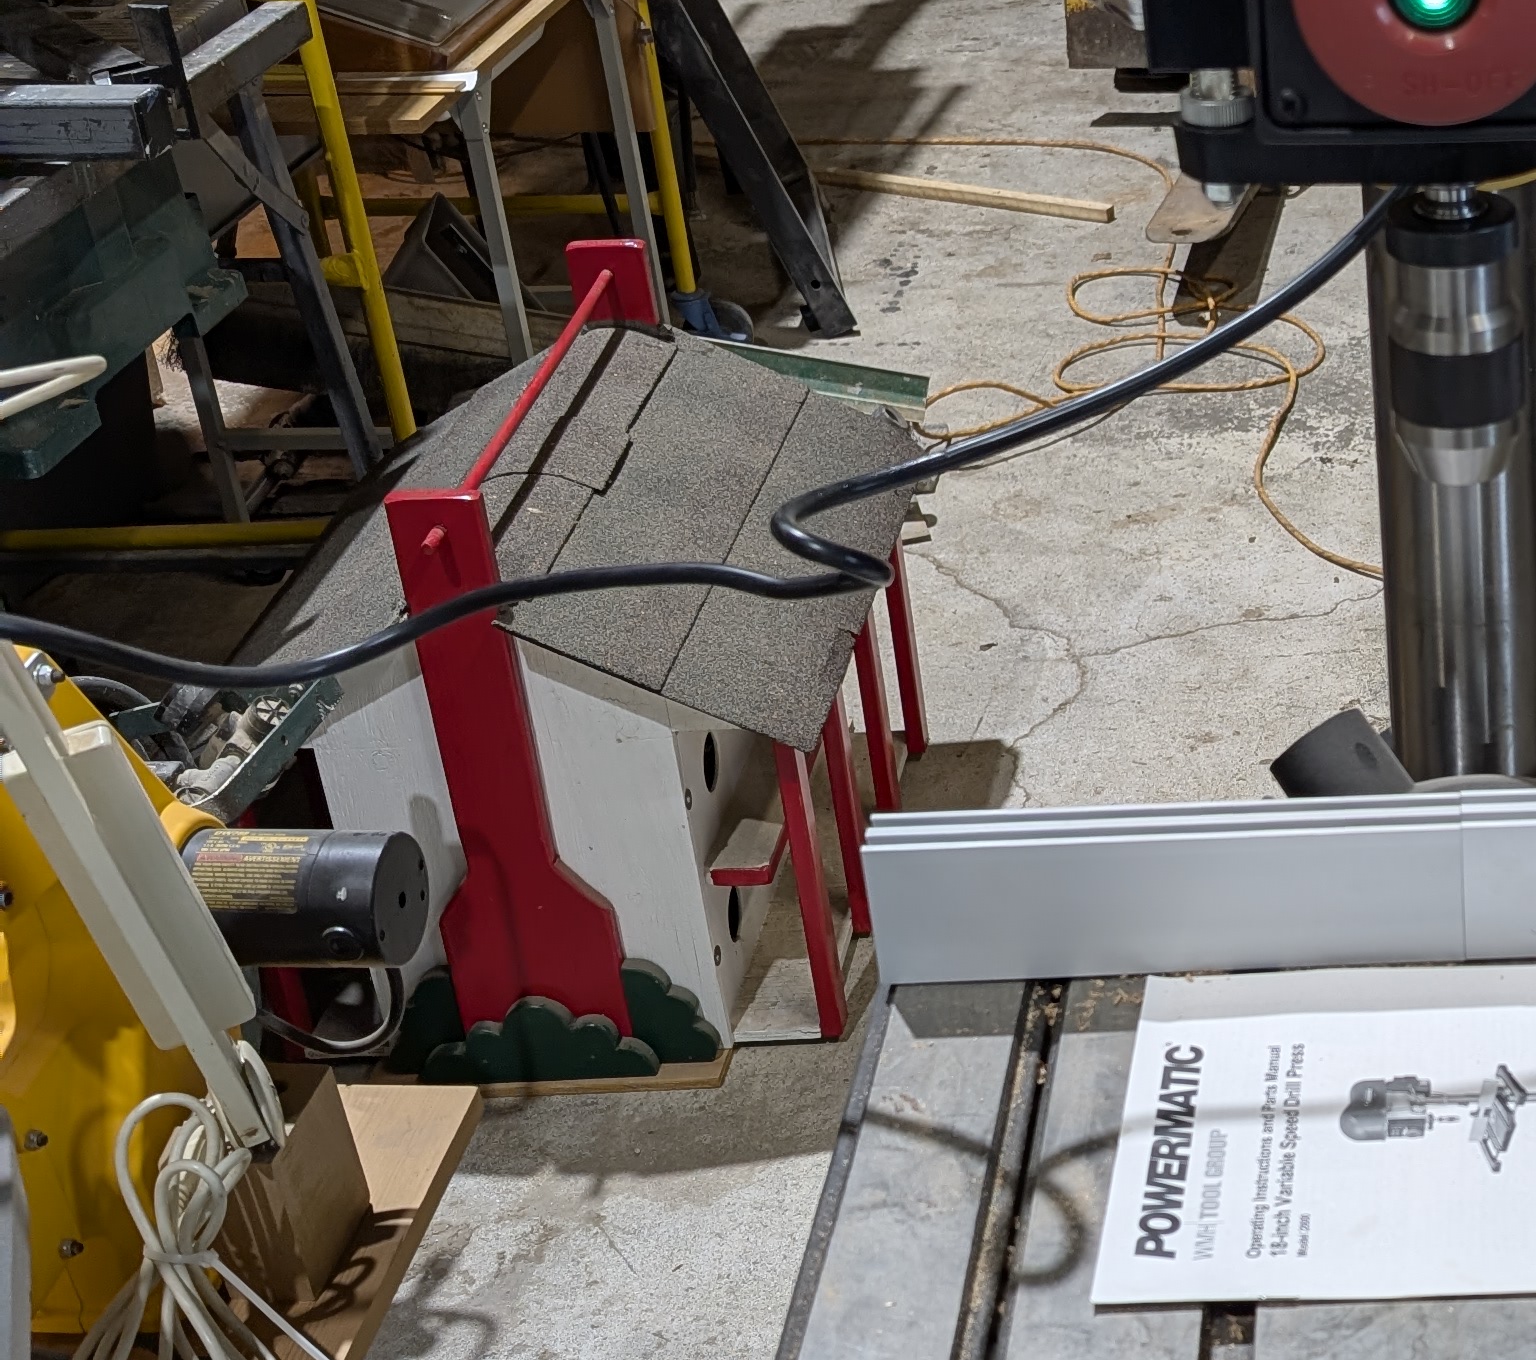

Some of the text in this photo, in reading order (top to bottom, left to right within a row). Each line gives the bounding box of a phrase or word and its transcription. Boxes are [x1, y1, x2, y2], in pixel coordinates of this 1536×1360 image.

[1134, 1044, 1205, 1258] POWERMATIC
[1193, 1128, 1228, 1261] WMH TOOL GROUP
[1246, 1045, 1281, 1259] Operating Instructions and Parts Manual
[1269, 1043, 1305, 1257] 18-inch Variable Speed Drill Press
